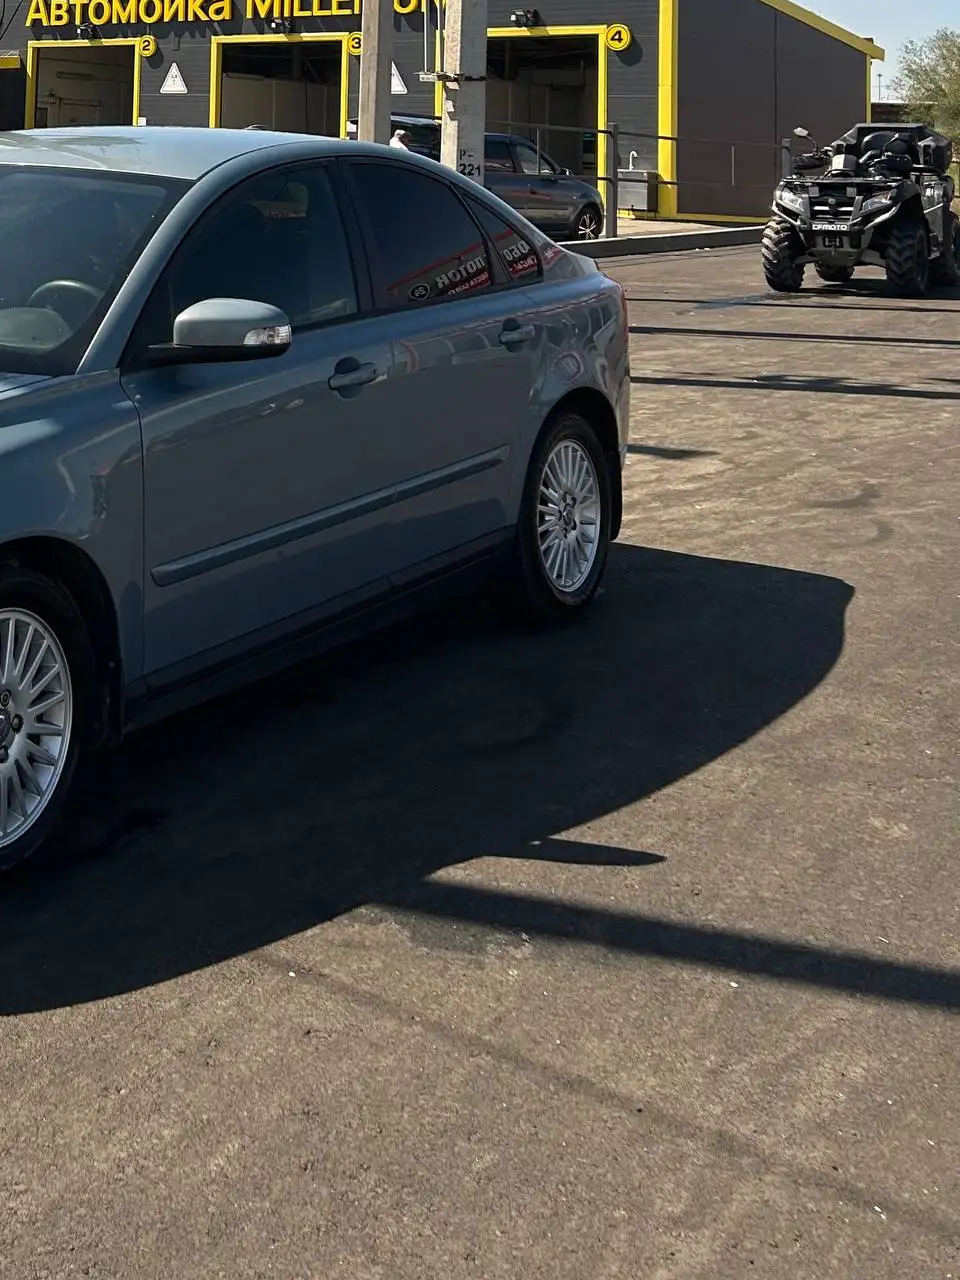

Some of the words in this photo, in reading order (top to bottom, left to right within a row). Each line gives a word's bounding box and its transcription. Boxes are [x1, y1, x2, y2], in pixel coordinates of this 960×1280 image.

[610, 30, 624, 43] 4
[142, 39, 151, 51] 2
[351, 37, 362, 50] 3
[459, 163, 481, 177] 221
